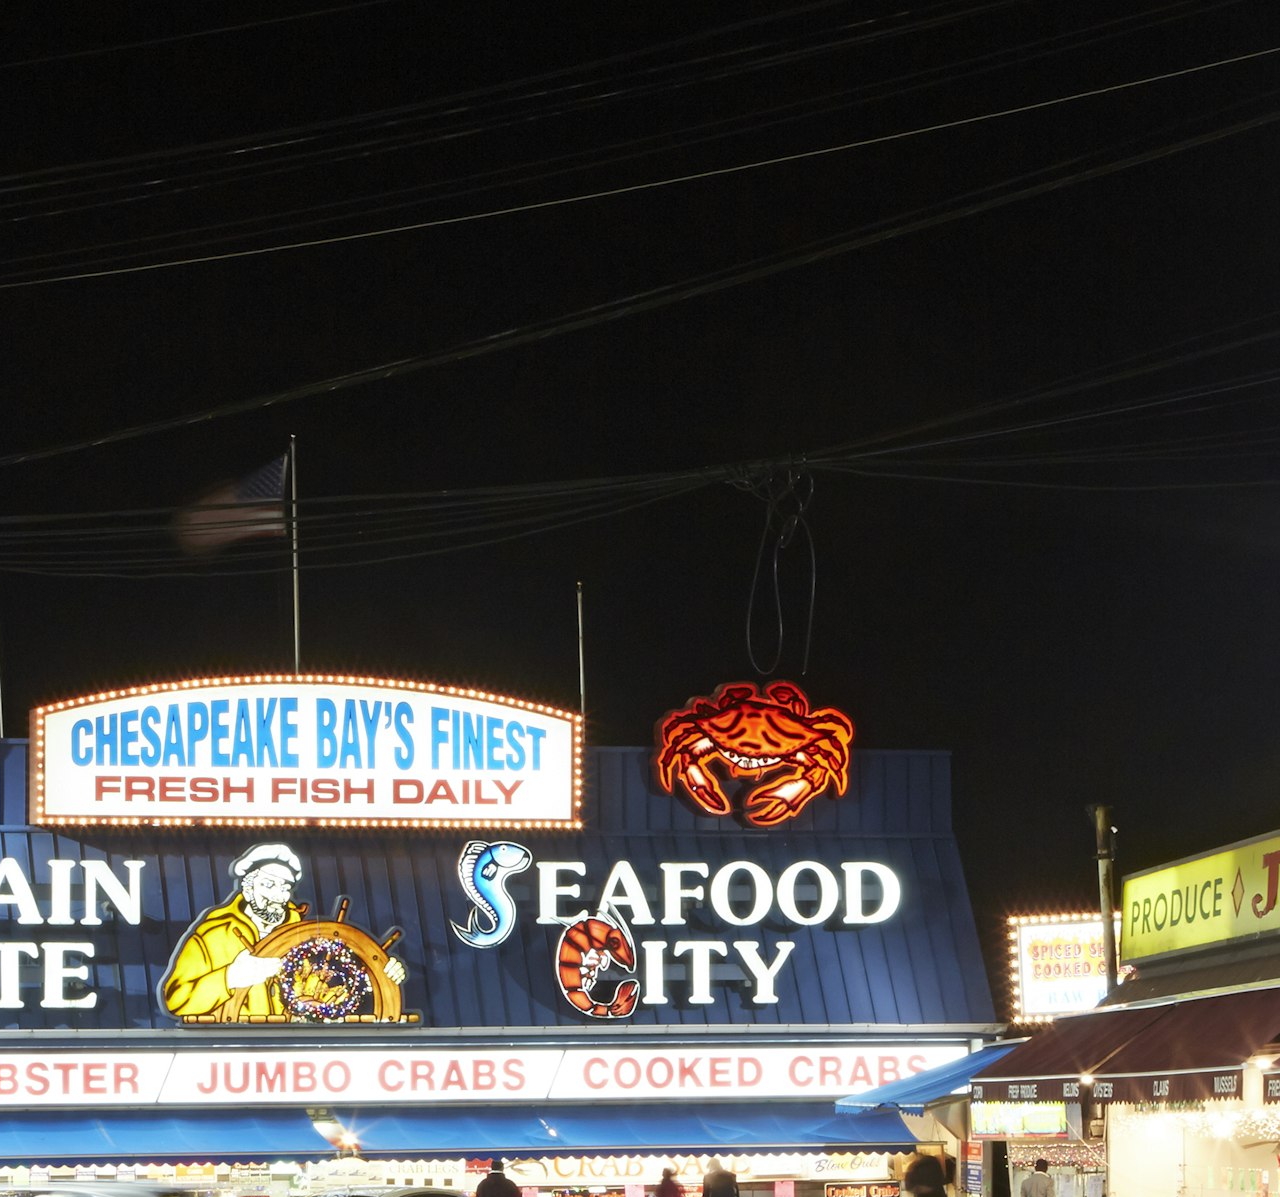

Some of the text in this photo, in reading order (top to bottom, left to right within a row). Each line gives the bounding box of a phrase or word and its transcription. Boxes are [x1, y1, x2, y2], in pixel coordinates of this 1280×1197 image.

[70, 696, 547, 773] CHESAPEAKE BAY'S FINEST
[94, 775, 525, 806] FRESH FISH DAILY
[1129, 876, 1223, 937] PRODUCE
[1033, 961, 1092, 979] COOKED
[197, 1057, 529, 1095] JUMBO CRABS
[582, 1055, 764, 1091] COOKED
